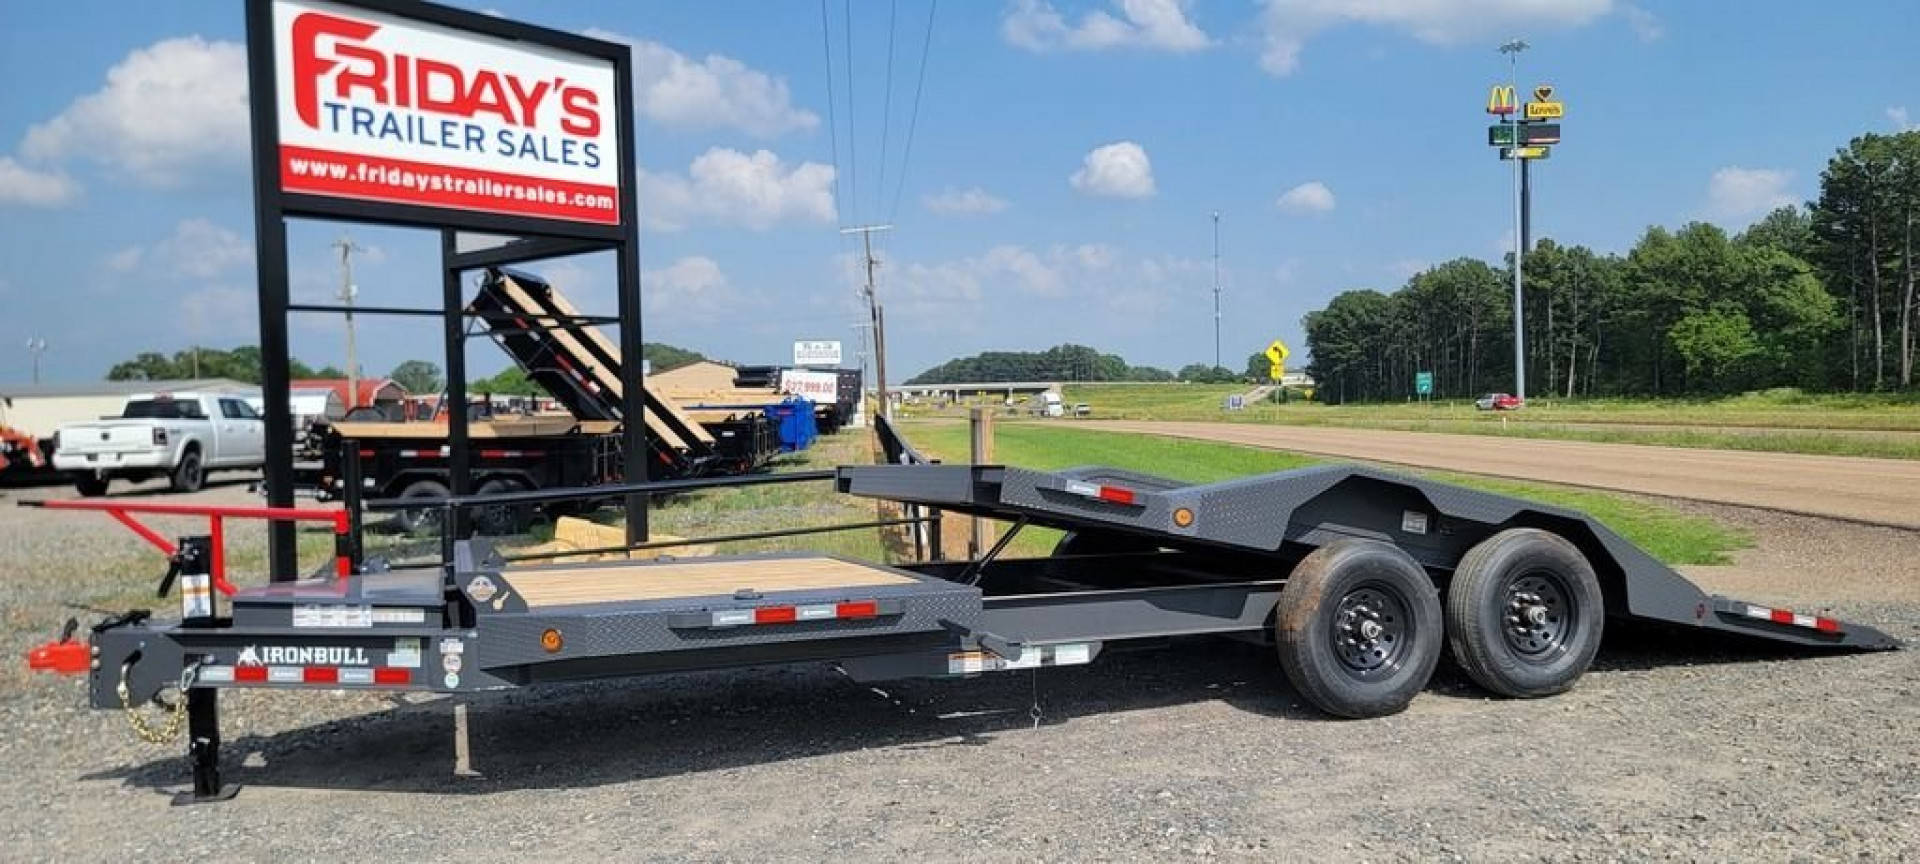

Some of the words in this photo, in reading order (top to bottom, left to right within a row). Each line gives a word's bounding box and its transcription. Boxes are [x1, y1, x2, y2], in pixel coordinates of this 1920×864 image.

[292, 12, 600, 138] FRIDAY'S
[323, 101, 486, 153] TRAILER
[497, 129, 601, 168] SALES
[289, 157, 614, 210] www.fridaystrailersales.com
[261, 646, 369, 665] IRONBULL
